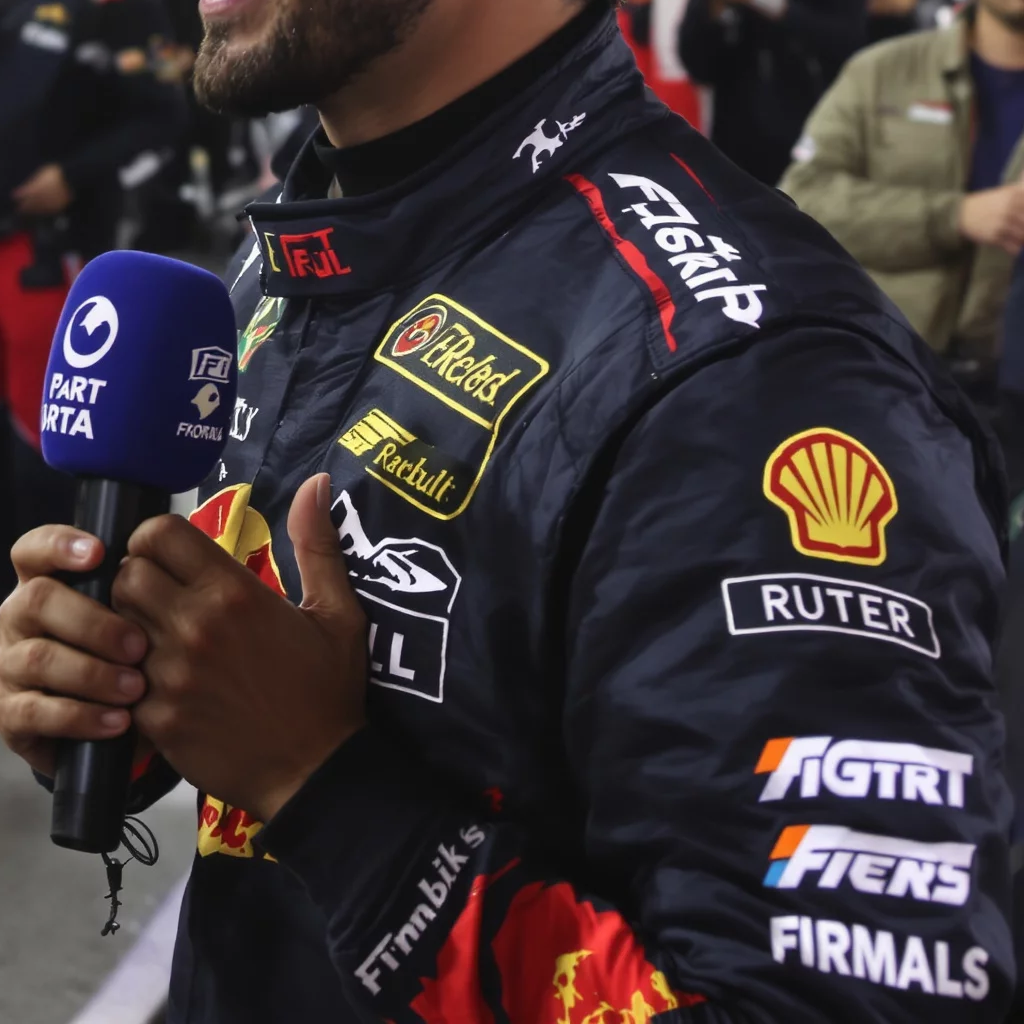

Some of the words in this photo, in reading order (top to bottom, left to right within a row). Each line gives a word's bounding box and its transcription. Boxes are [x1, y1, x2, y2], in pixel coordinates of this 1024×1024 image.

[49, 372, 107, 405] PART
[761, 584, 915, 638] RUTER
[770, 915, 990, 1001] FIRMALS
